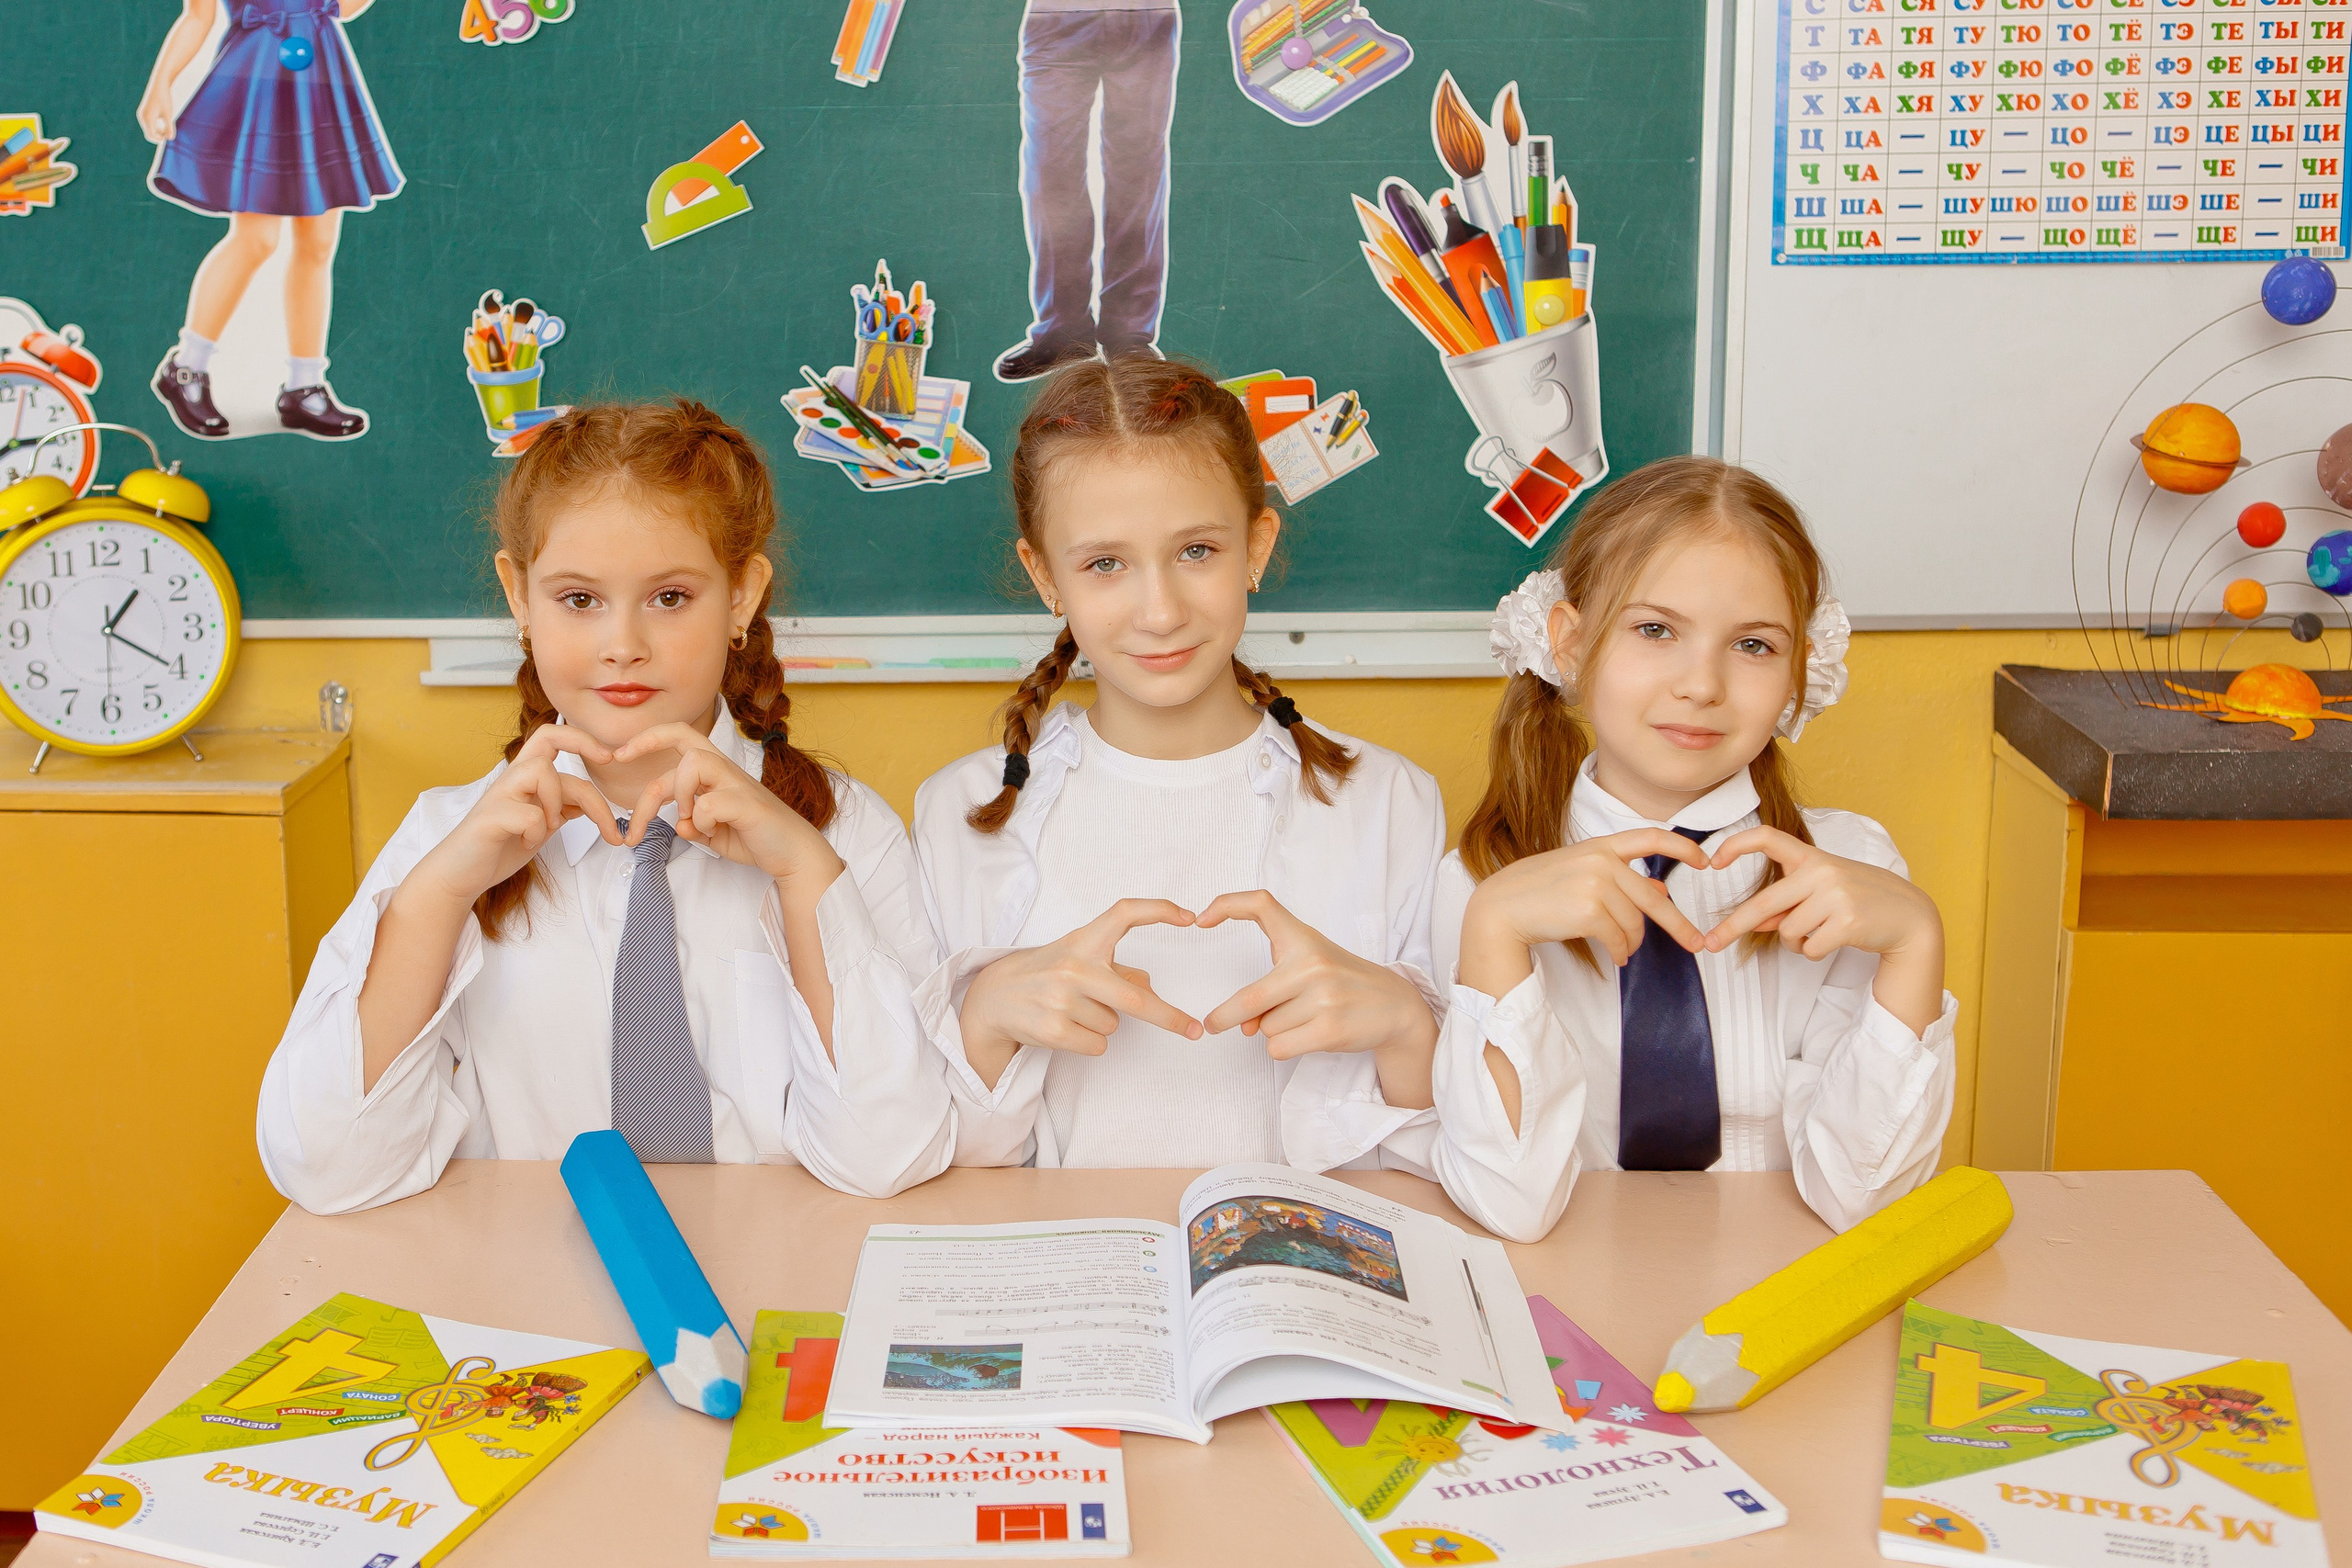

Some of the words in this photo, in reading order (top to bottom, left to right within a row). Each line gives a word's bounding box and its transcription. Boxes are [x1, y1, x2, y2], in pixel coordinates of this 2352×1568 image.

[1805, 26, 1824, 47] Т
[1849, 28, 1883, 46] ТА
[1901, 26, 1934, 45] ТЯ
[1953, 26, 1986, 44] ТУ
[2000, 25, 2041, 44] ТЮ
[2056, 24, 2091, 42] ТО
[2109, 19, 2143, 41] ТЁ
[2160, 22, 2194, 41] ТЭ
[2211, 22, 2245, 40] ТЕ
[2259, 20, 2300, 39] ТЫ
[2311, 20, 2344, 39] ТИ
[1801, 61, 1826, 81] Ф
[1847, 62, 1885, 80] ФА
[1897, 61, 1935, 79] ФЯ
[1950, 60, 1987, 79] ФУ
[1997, 60, 2043, 79] ФЮ
[2052, 59, 2094, 77] ФО
[2105, 54, 2141, 76] ФЁ
[2155, 57, 2193, 75] ФЭ
[2207, 56, 2243, 74] ФЕ
[2255, 56, 2299, 74] ФЫ
[2306, 55, 2344, 73] ФИ
[1804, 95, 1823, 116] Х
[1844, 96, 1882, 114] ХА
[1896, 94, 1933, 114] ХЯ
[1950, 95, 1984, 113] ХУ
[1996, 93, 2041, 112] ХЮ
[2052, 93, 2089, 111] ХО
[2103, 88, 2139, 110] ХЁ
[2157, 91, 2193, 109] ХЭ
[2208, 90, 2242, 108] ХЕ
[2255, 88, 2297, 107] ХЫ
[2305, 88, 2342, 107] ХИ
[1801, 129, 1824, 152] Ц
[1845, 130, 1883, 150] ЦА
[1949, 129, 1985, 148] ЦУ
[2051, 127, 2088, 146] ЦО
[2154, 125, 2190, 145] ЦЭ
[2205, 125, 2240, 144] ЦЕ
[2251, 124, 2295, 143] ЦЫ
[2303, 123, 2341, 143] ЦИ
[1801, 163, 1820, 186] Ч
[1843, 164, 1880, 182] ЧА
[1948, 163, 1982, 181] ЧУ
[2050, 161, 2086, 180] ЧО
[2101, 156, 2134, 178] ЧЁ
[2202, 159, 2236, 177] ЧЕ
[2302, 157, 2338, 176] ЧИ
[1794, 197, 1826, 218] Ш
[1840, 198, 1883, 215] ША
[1943, 197, 1985, 214] ШУ
[1990, 197, 2038, 213] ШЮ
[2046, 196, 2089, 213] ШО
[2096, 192, 2137, 212] ШЁ
[2147, 194, 2189, 211] ШЭ
[2200, 193, 2240, 211] ШЕ
[2298, 193, 2338, 209] ШИ
[1793, 228, 1828, 252] Щ
[1838, 230, 1883, 249] ЩА
[1940, 229, 1983, 249] ЩУ
[2043, 228, 2086, 247] ЩО
[2096, 224, 2137, 248] ЩЁ
[2196, 225, 2237, 245] ЩЕ
[2295, 225, 2337, 244] ЩИ
[27, 391, 36, 408] 1
[47, 405, 58, 422] 2
[49, 550, 74, 577] 11
[87, 539, 120, 567] 12
[141, 547, 153, 574] 1
[18, 581, 51, 610] 10
[167, 575, 189, 602] 2
[8, 619, 30, 650] 9
[183, 613, 203, 642] 3
[27, 660, 48, 690] 8
[167, 653, 187, 680] 4
[60, 689, 79, 716] 7
[100, 694, 121, 724] 6
[142, 683, 162, 712] 5
[220, 1327, 400, 1412] 4
[345, 1392, 397, 1401] СОНАТА
[1915, 1342, 2048, 1430] 4
[205, 1415, 277, 1430] УВЕРТЮРА
[279, 1407, 337, 1416] КОНЦЕРТ
[332, 1412, 401, 1426] ВАРИАЦИИ
[882, 1432, 949, 1443] народ
[954, 1431, 1040, 1444] Каждый
[836, 1447, 1062, 1468] искусство
[773, 1465, 1109, 1486] Изобразительное
[1432, 1445, 1719, 1501] Технология
[204, 1461, 438, 1529] Музыка
[1994, 1483, 2278, 1548] Музыка
